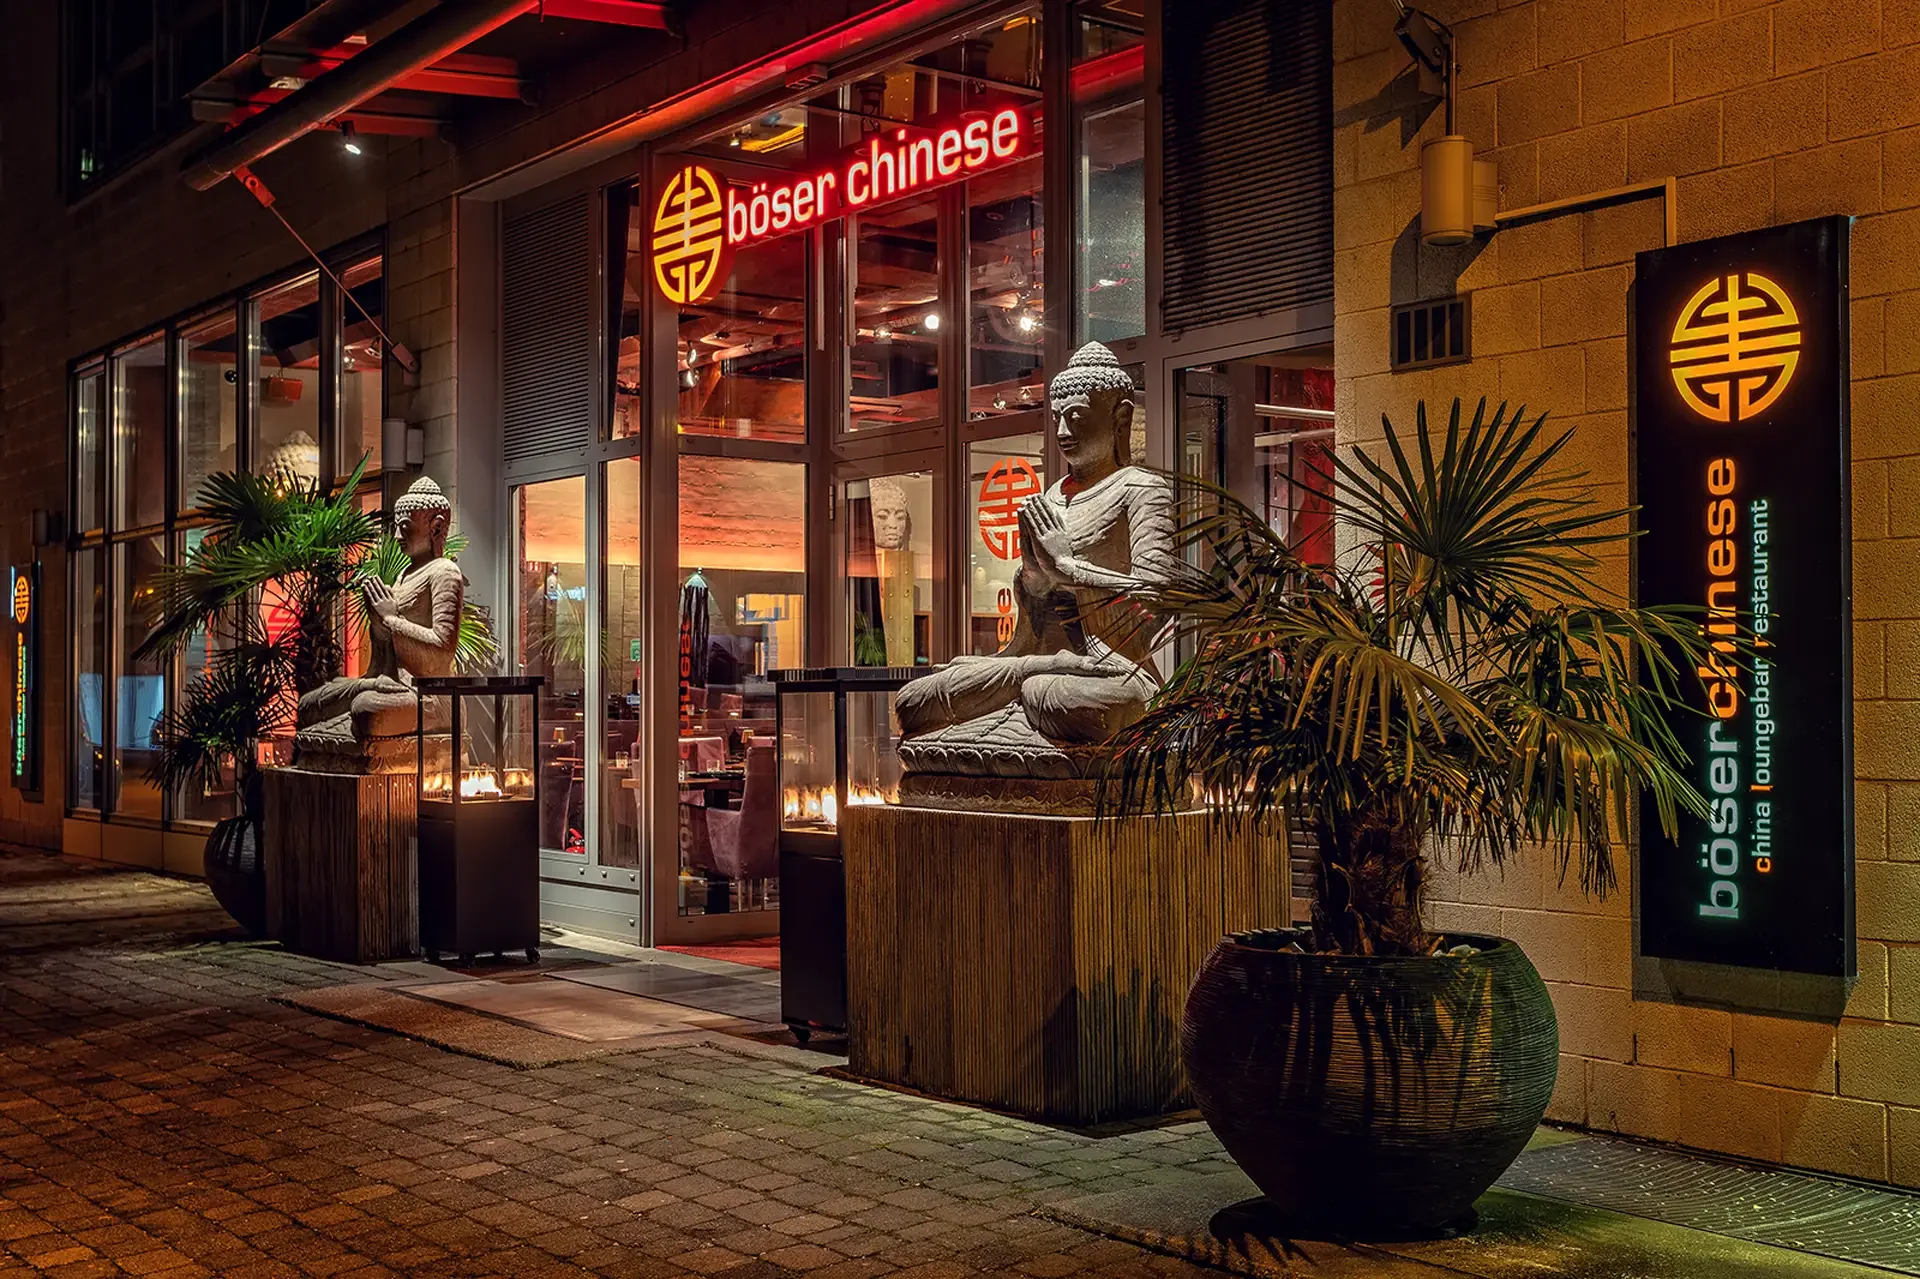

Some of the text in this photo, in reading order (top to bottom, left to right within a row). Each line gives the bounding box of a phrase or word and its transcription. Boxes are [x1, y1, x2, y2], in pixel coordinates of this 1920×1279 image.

[728, 109, 1019, 244] böser chinese
[1750, 499, 1775, 874] china loungebar restaurant
